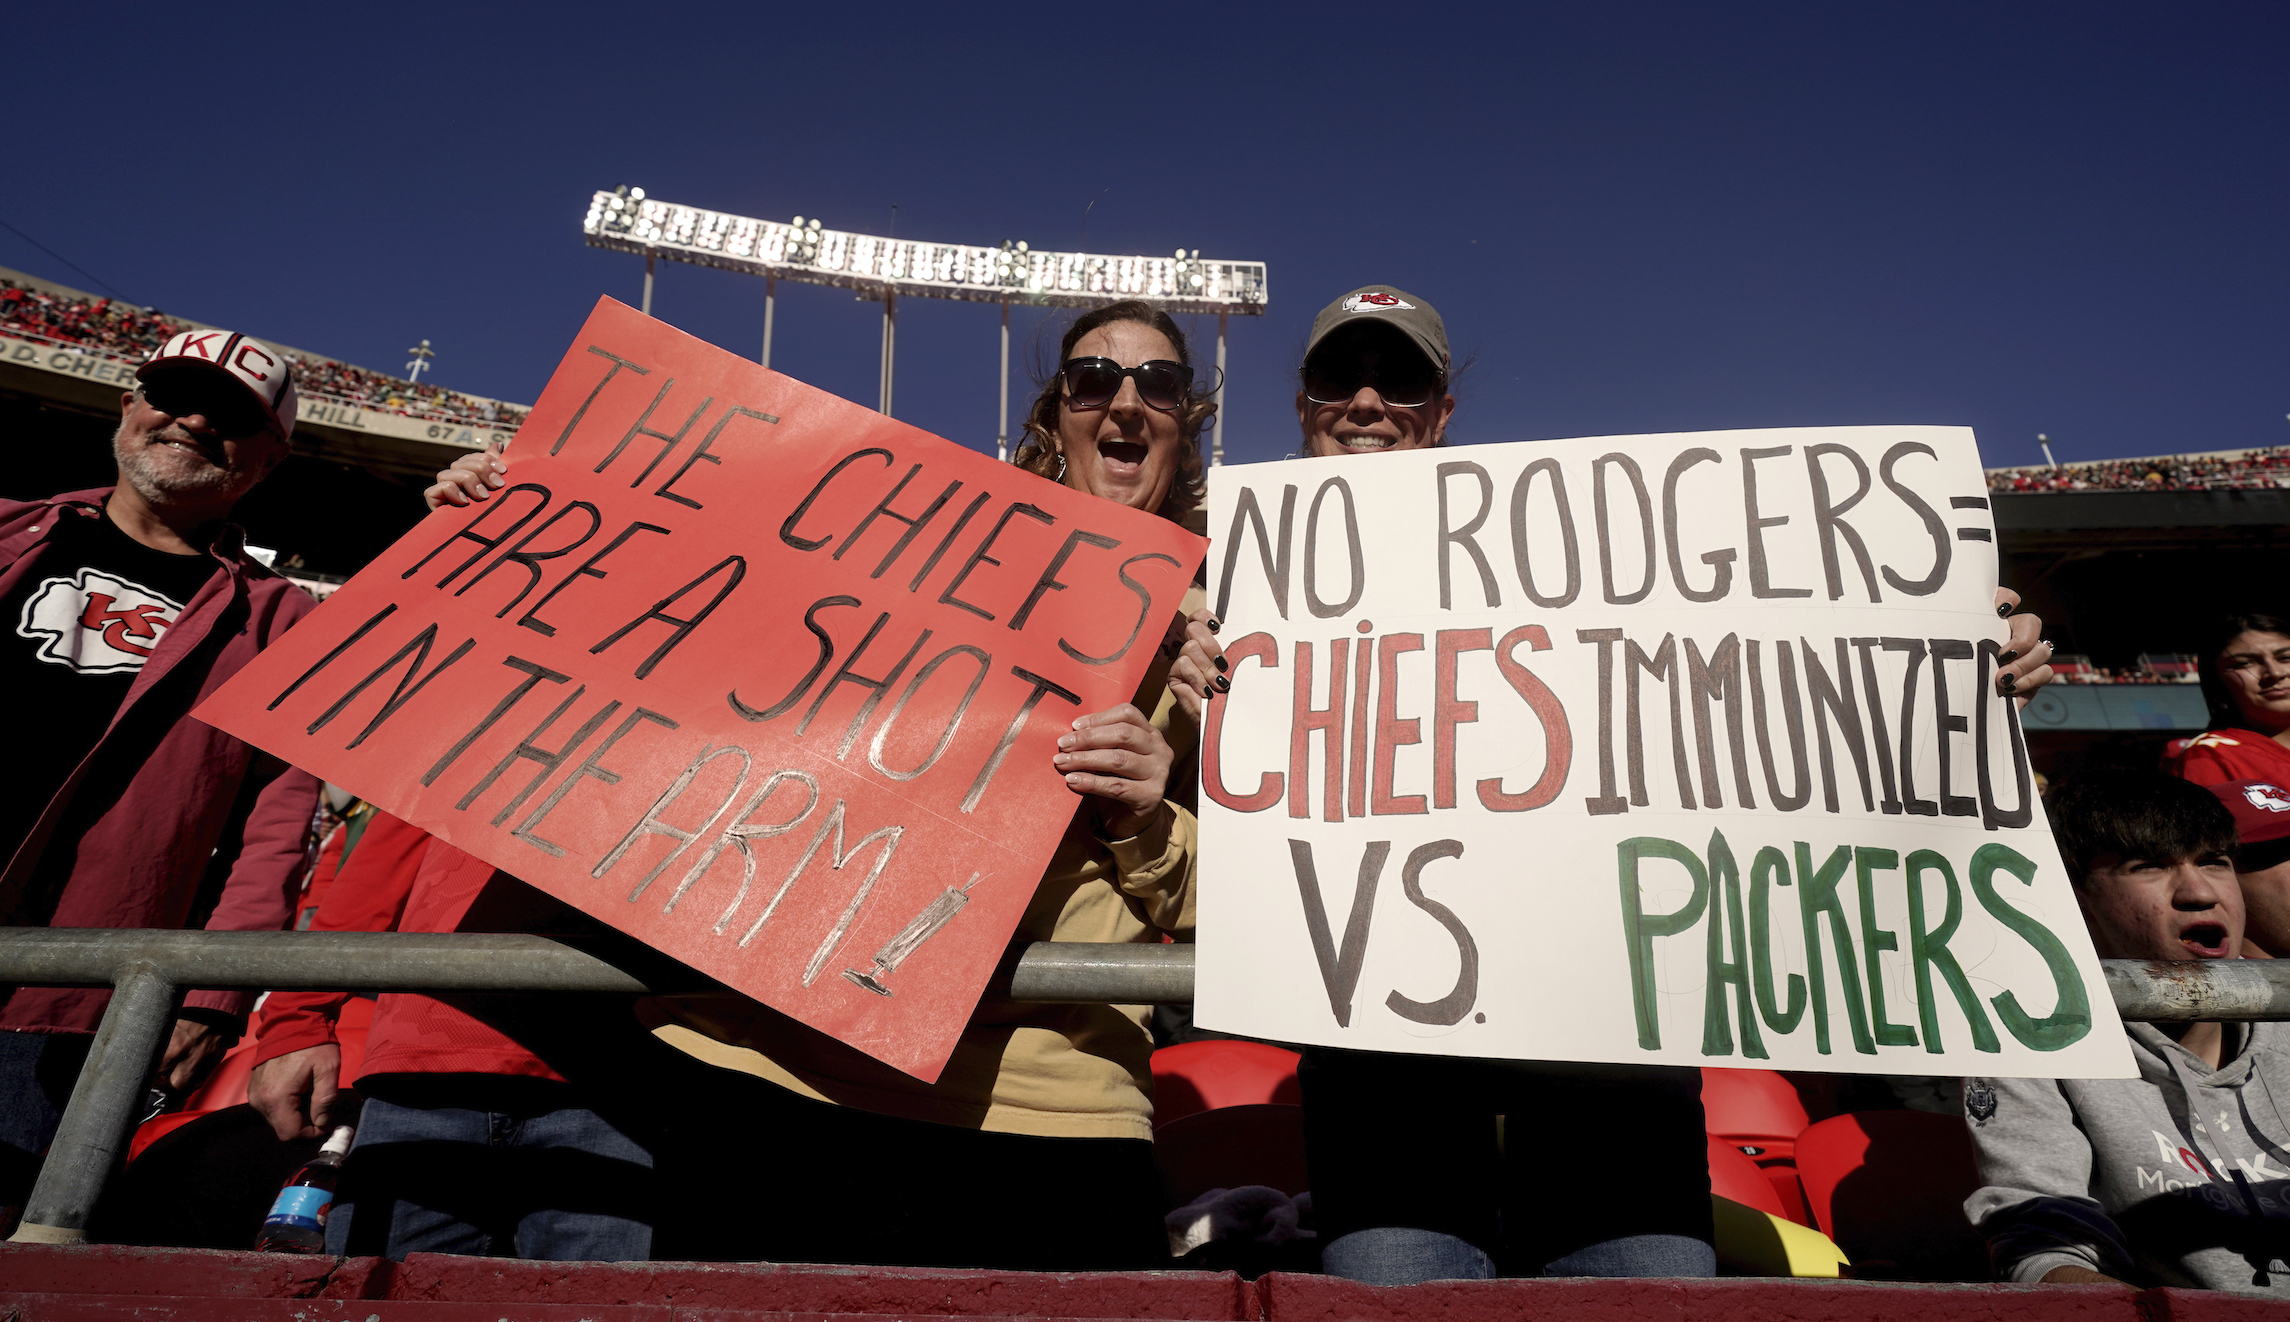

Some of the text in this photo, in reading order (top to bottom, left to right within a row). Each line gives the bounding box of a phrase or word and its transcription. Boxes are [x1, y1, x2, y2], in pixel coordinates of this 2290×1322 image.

[11, 344, 41, 364] D.
[306, 402, 366, 430] HILL
[427, 424, 455, 440] 67
[550, 345, 1181, 664] THE CHIEFS
[1219, 475, 1365, 624] NO
[267, 603, 477, 750] IN
[420, 654, 680, 859] THE
[401, 483, 1082, 814] ARE A SHOT
[1576, 627, 2032, 831] IMMUNIZED
[1287, 826, 2092, 1060] VS. PACKERS
[2136, 1165, 2278, 1212] Mortgae
